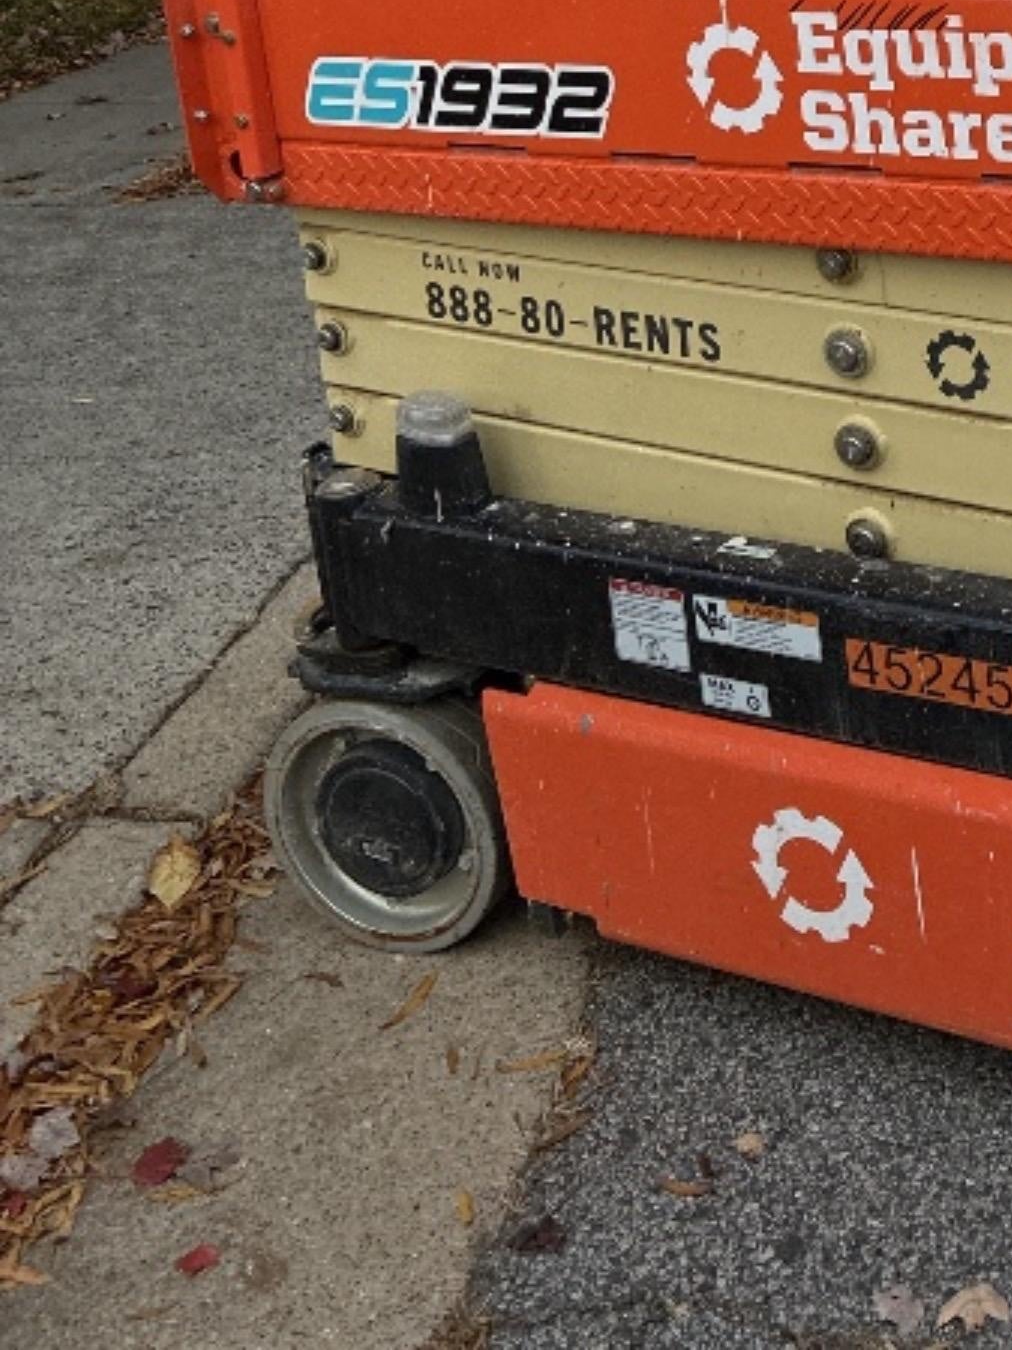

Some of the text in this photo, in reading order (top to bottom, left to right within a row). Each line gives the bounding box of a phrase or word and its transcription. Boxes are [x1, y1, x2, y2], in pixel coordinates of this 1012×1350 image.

[305, 58, 613, 136] ES1932
[421, 251, 521, 283] CALL NOW
[425, 281, 722, 362] 888-80-RENTS
